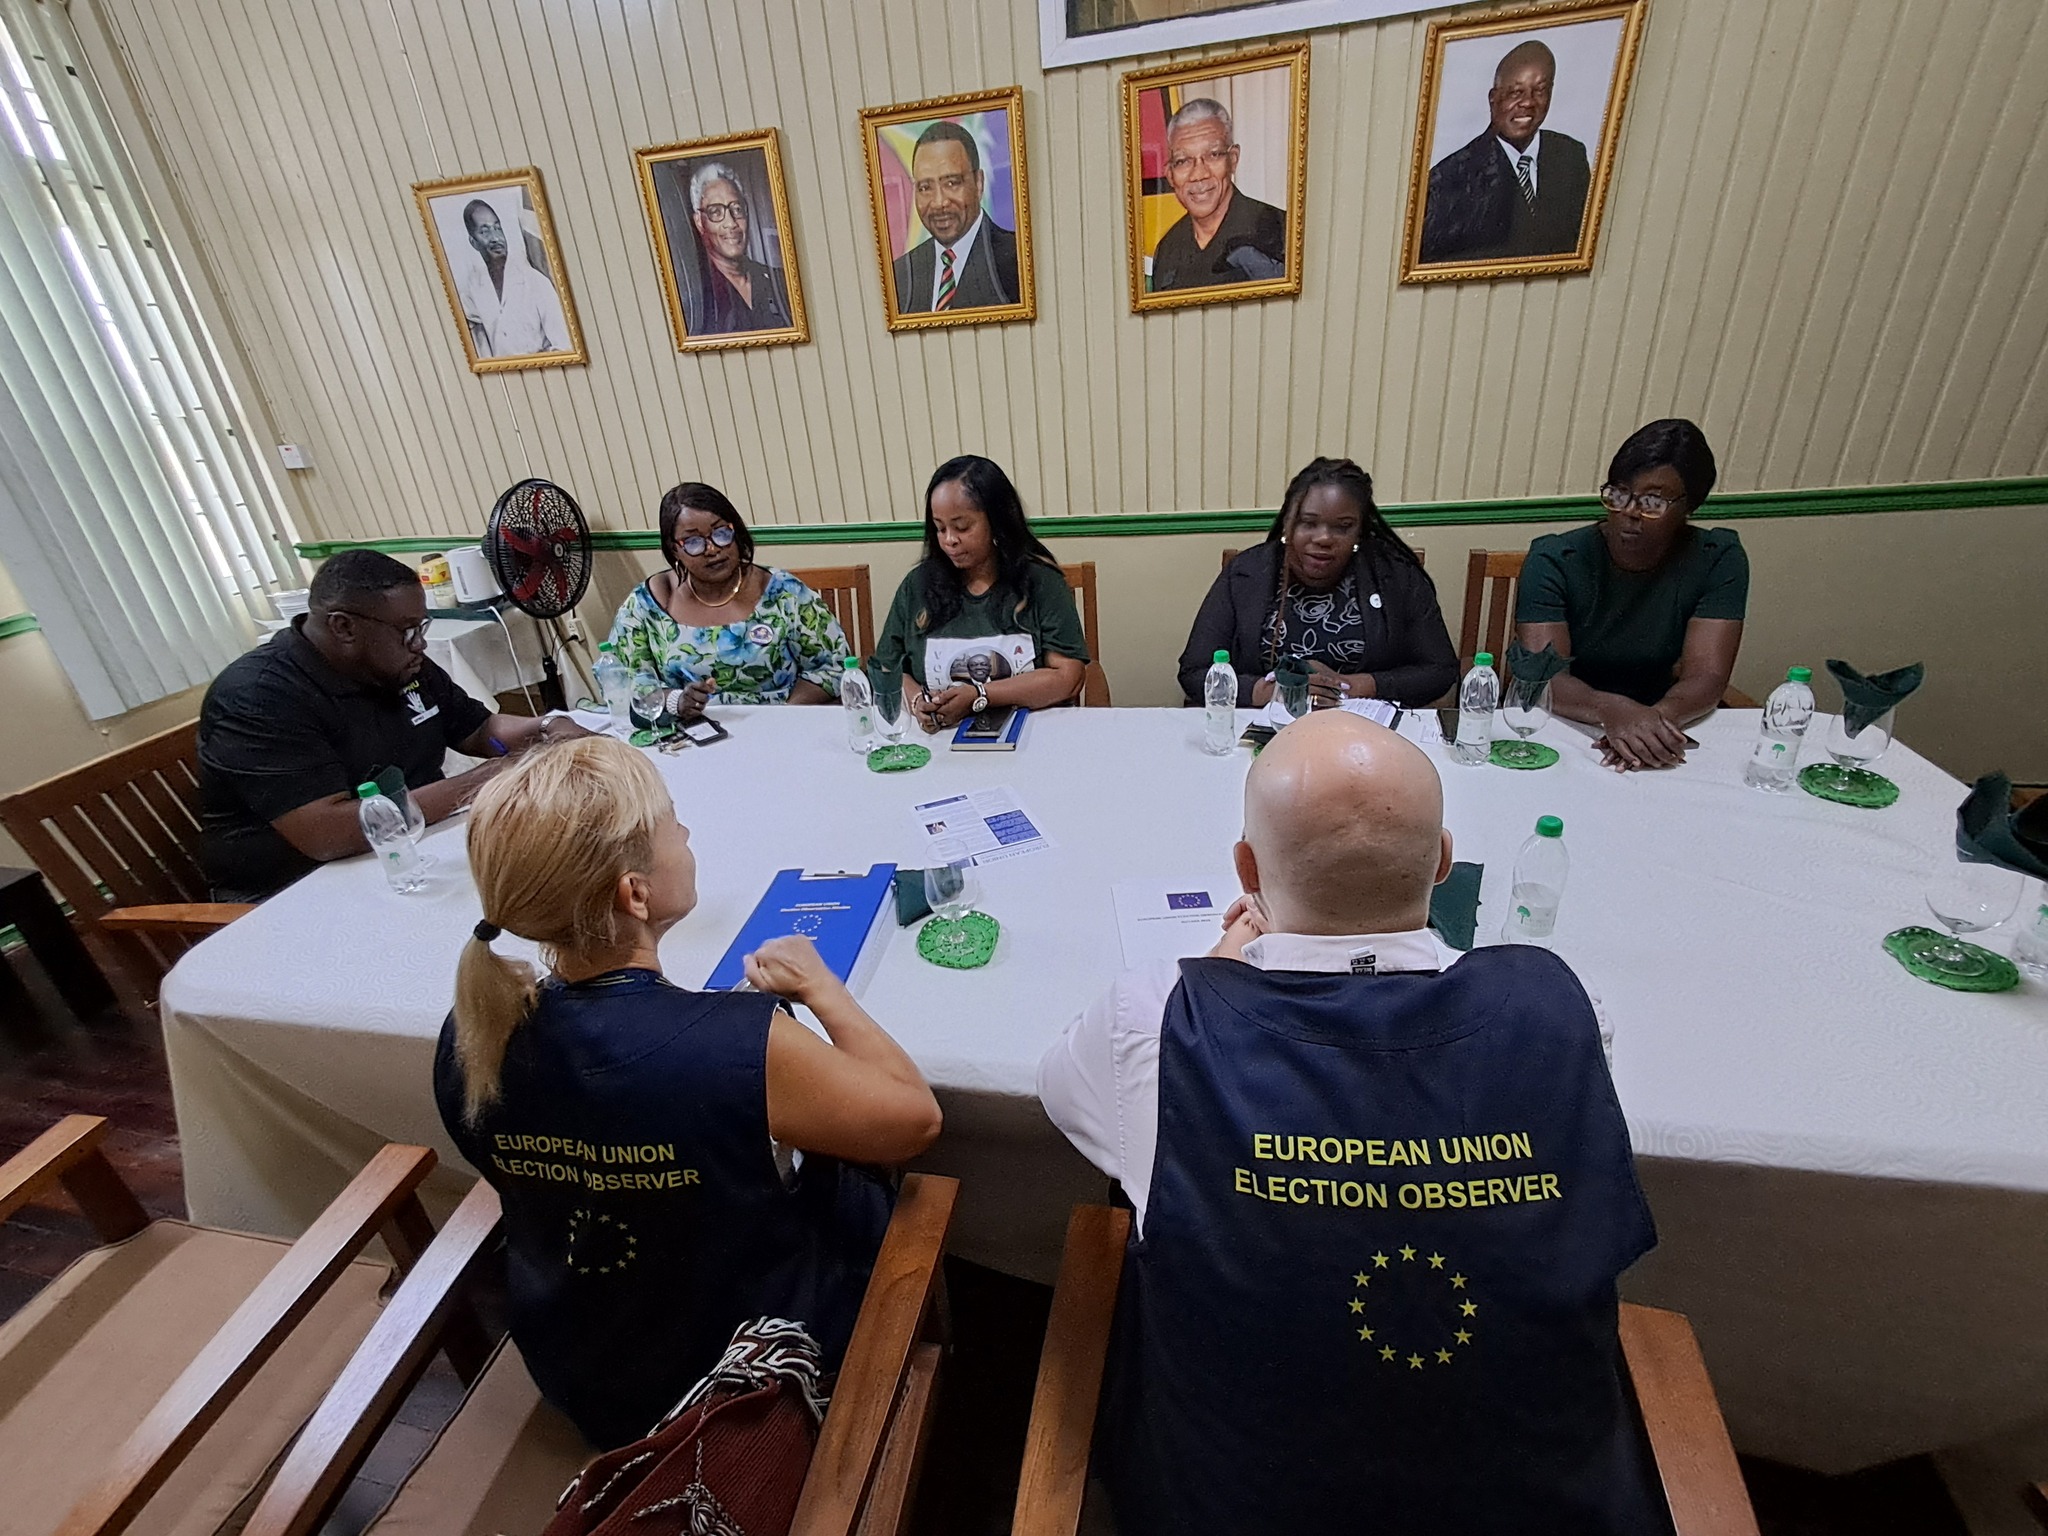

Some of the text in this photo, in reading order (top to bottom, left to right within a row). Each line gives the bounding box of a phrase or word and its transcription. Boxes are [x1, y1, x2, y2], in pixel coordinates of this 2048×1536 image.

[494, 1134, 675, 1164] EUROPEAN UNION
[1254, 1132, 1533, 1166] EUROPEAN UNION
[491, 1153, 700, 1191] ELECTION OBSERVER
[1234, 1167, 1562, 1209] ELECTION OBSERVER
